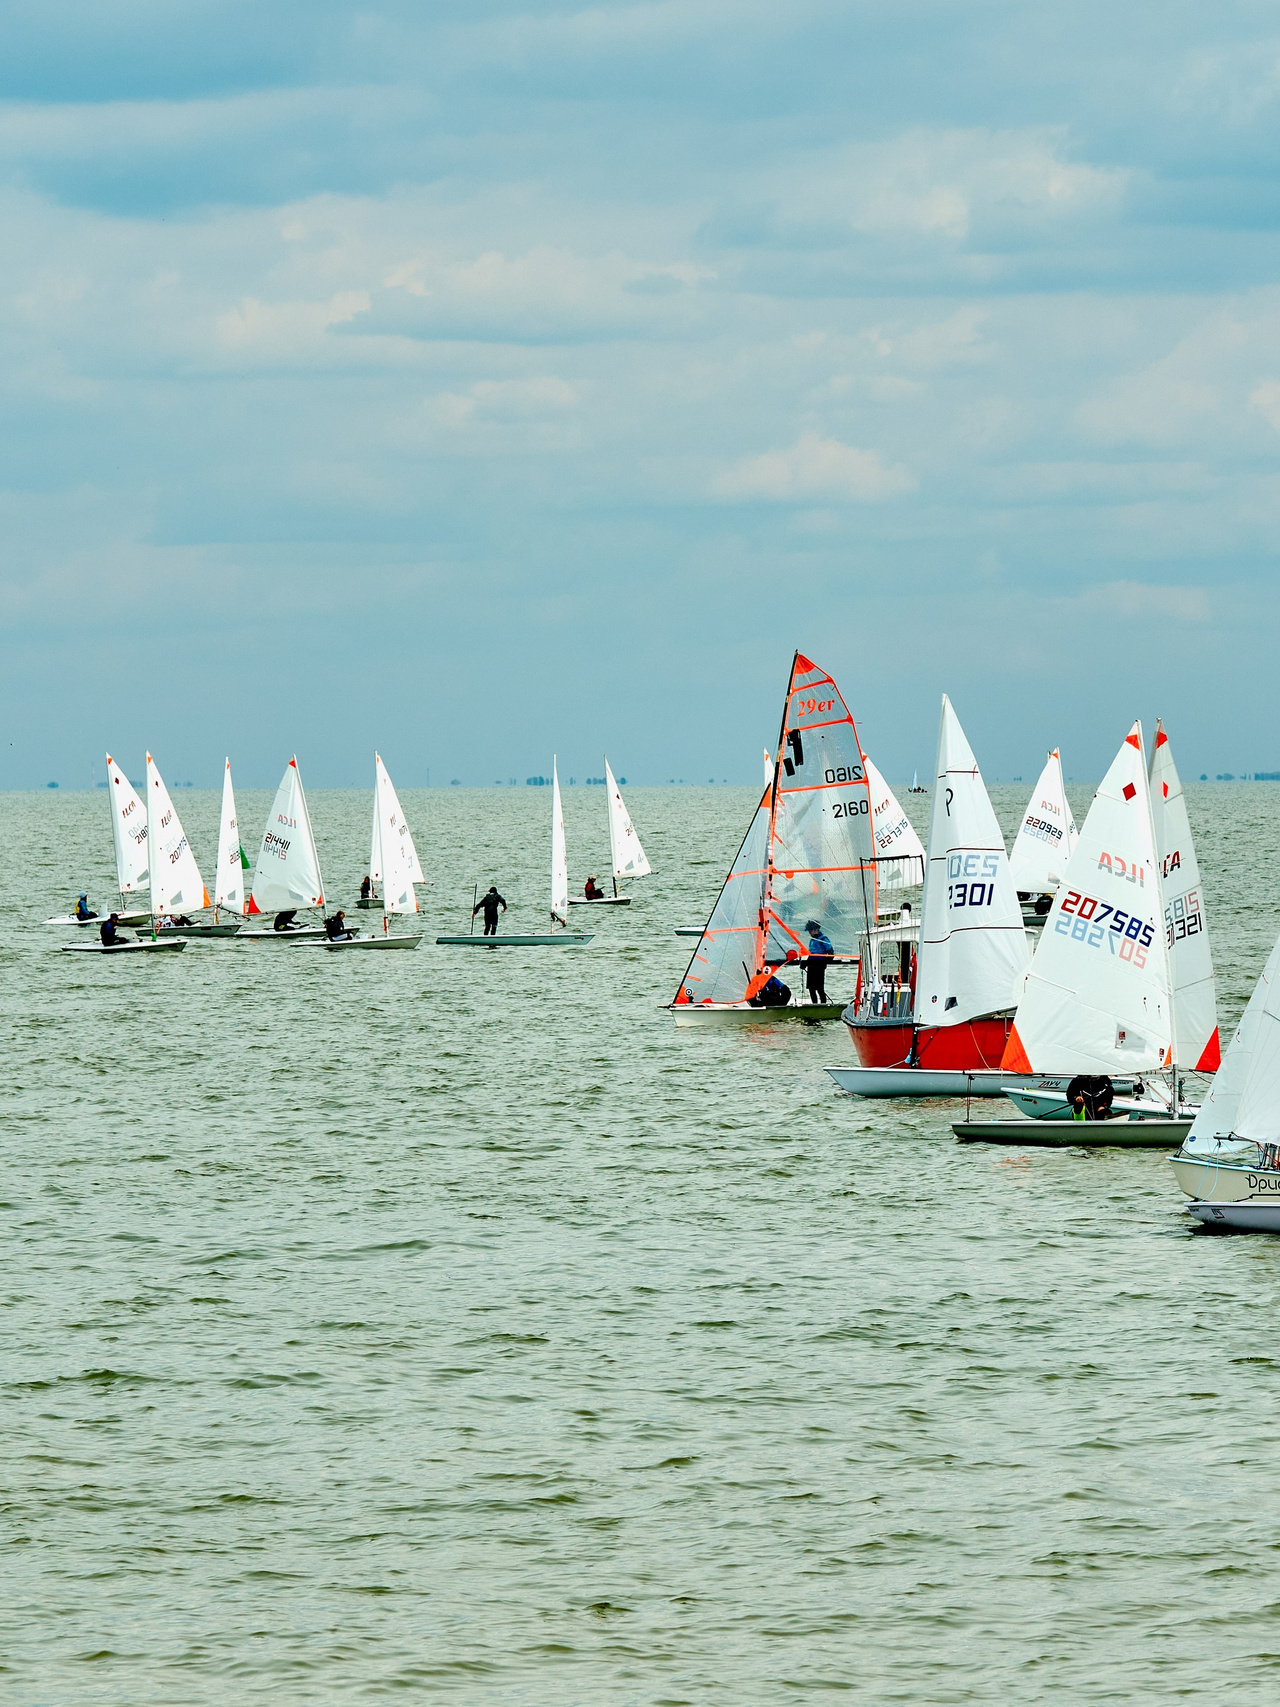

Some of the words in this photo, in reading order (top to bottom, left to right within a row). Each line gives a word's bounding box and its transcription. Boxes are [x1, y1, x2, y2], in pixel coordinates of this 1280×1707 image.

[797, 698, 835, 717] 29er
[122, 800, 136, 818] ILCA
[832, 800, 869, 818] 2160
[874, 799, 890, 816] ILCA
[878, 819, 908, 849] 227375
[1026, 816, 1063, 840] 220929
[265, 832, 291, 851] 214411
[1061, 891, 1155, 947] 207585
